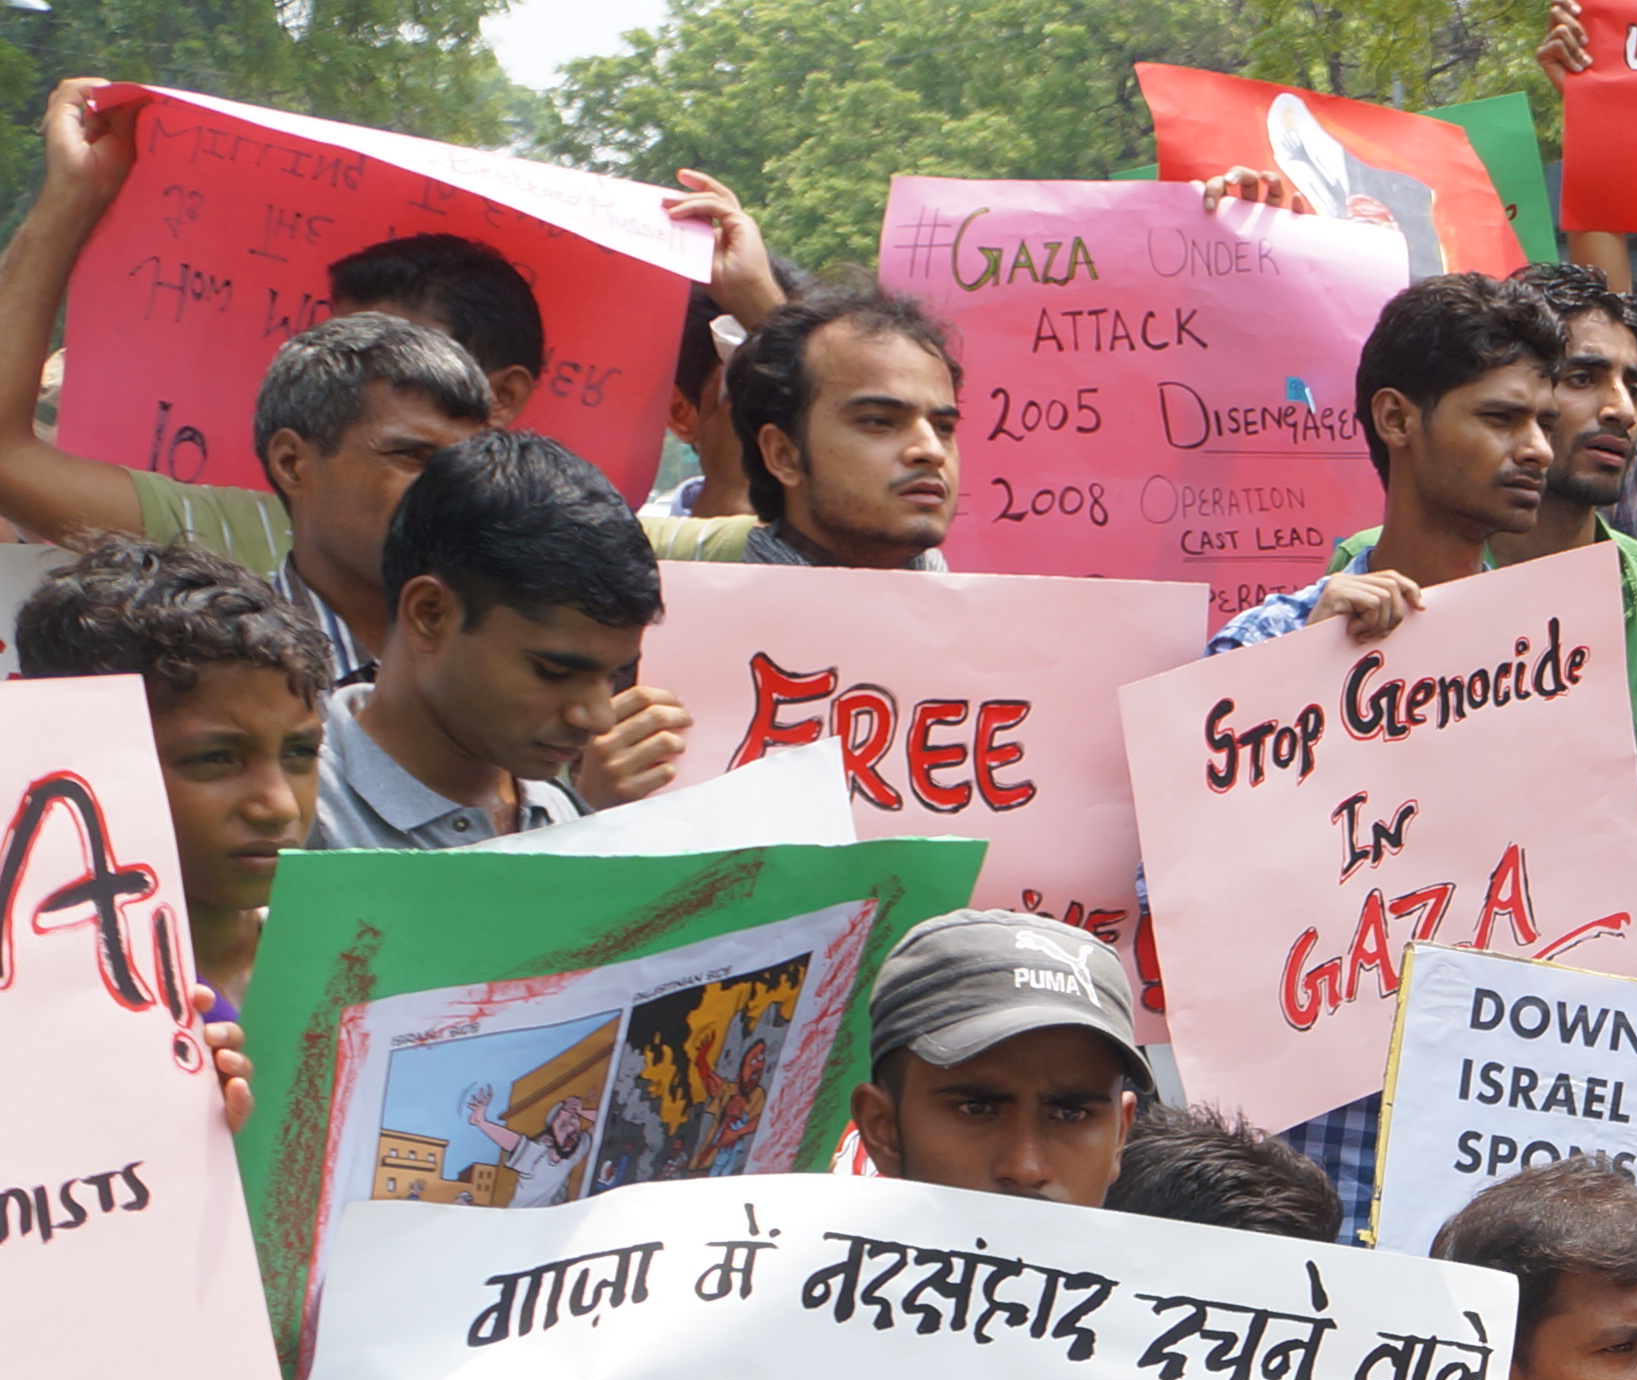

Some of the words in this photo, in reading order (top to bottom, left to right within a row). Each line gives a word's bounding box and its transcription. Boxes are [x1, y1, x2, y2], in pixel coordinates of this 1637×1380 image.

[894, 205, 1100, 292] #GAZA
[1148, 227, 1281, 277] UNDER
[1033, 308, 1209, 353] ATTACK
[987, 387, 1102, 442] 2005
[991, 477, 1110, 526] 2008
[1140, 474, 1306, 524] OPERATION
[1181, 529, 1240, 555] CAST
[1255, 528, 1324, 552] LEAD
[724, 650, 1039, 814] FREE
[1280, 842, 1541, 1033] GAZA
[1014, 967, 1081, 996] PUMA
[1458, 1058, 1631, 1124] ISRAEL
[466, 1239, 664, 1350] गाज़ा
[694, 1202, 782, 1303] में
